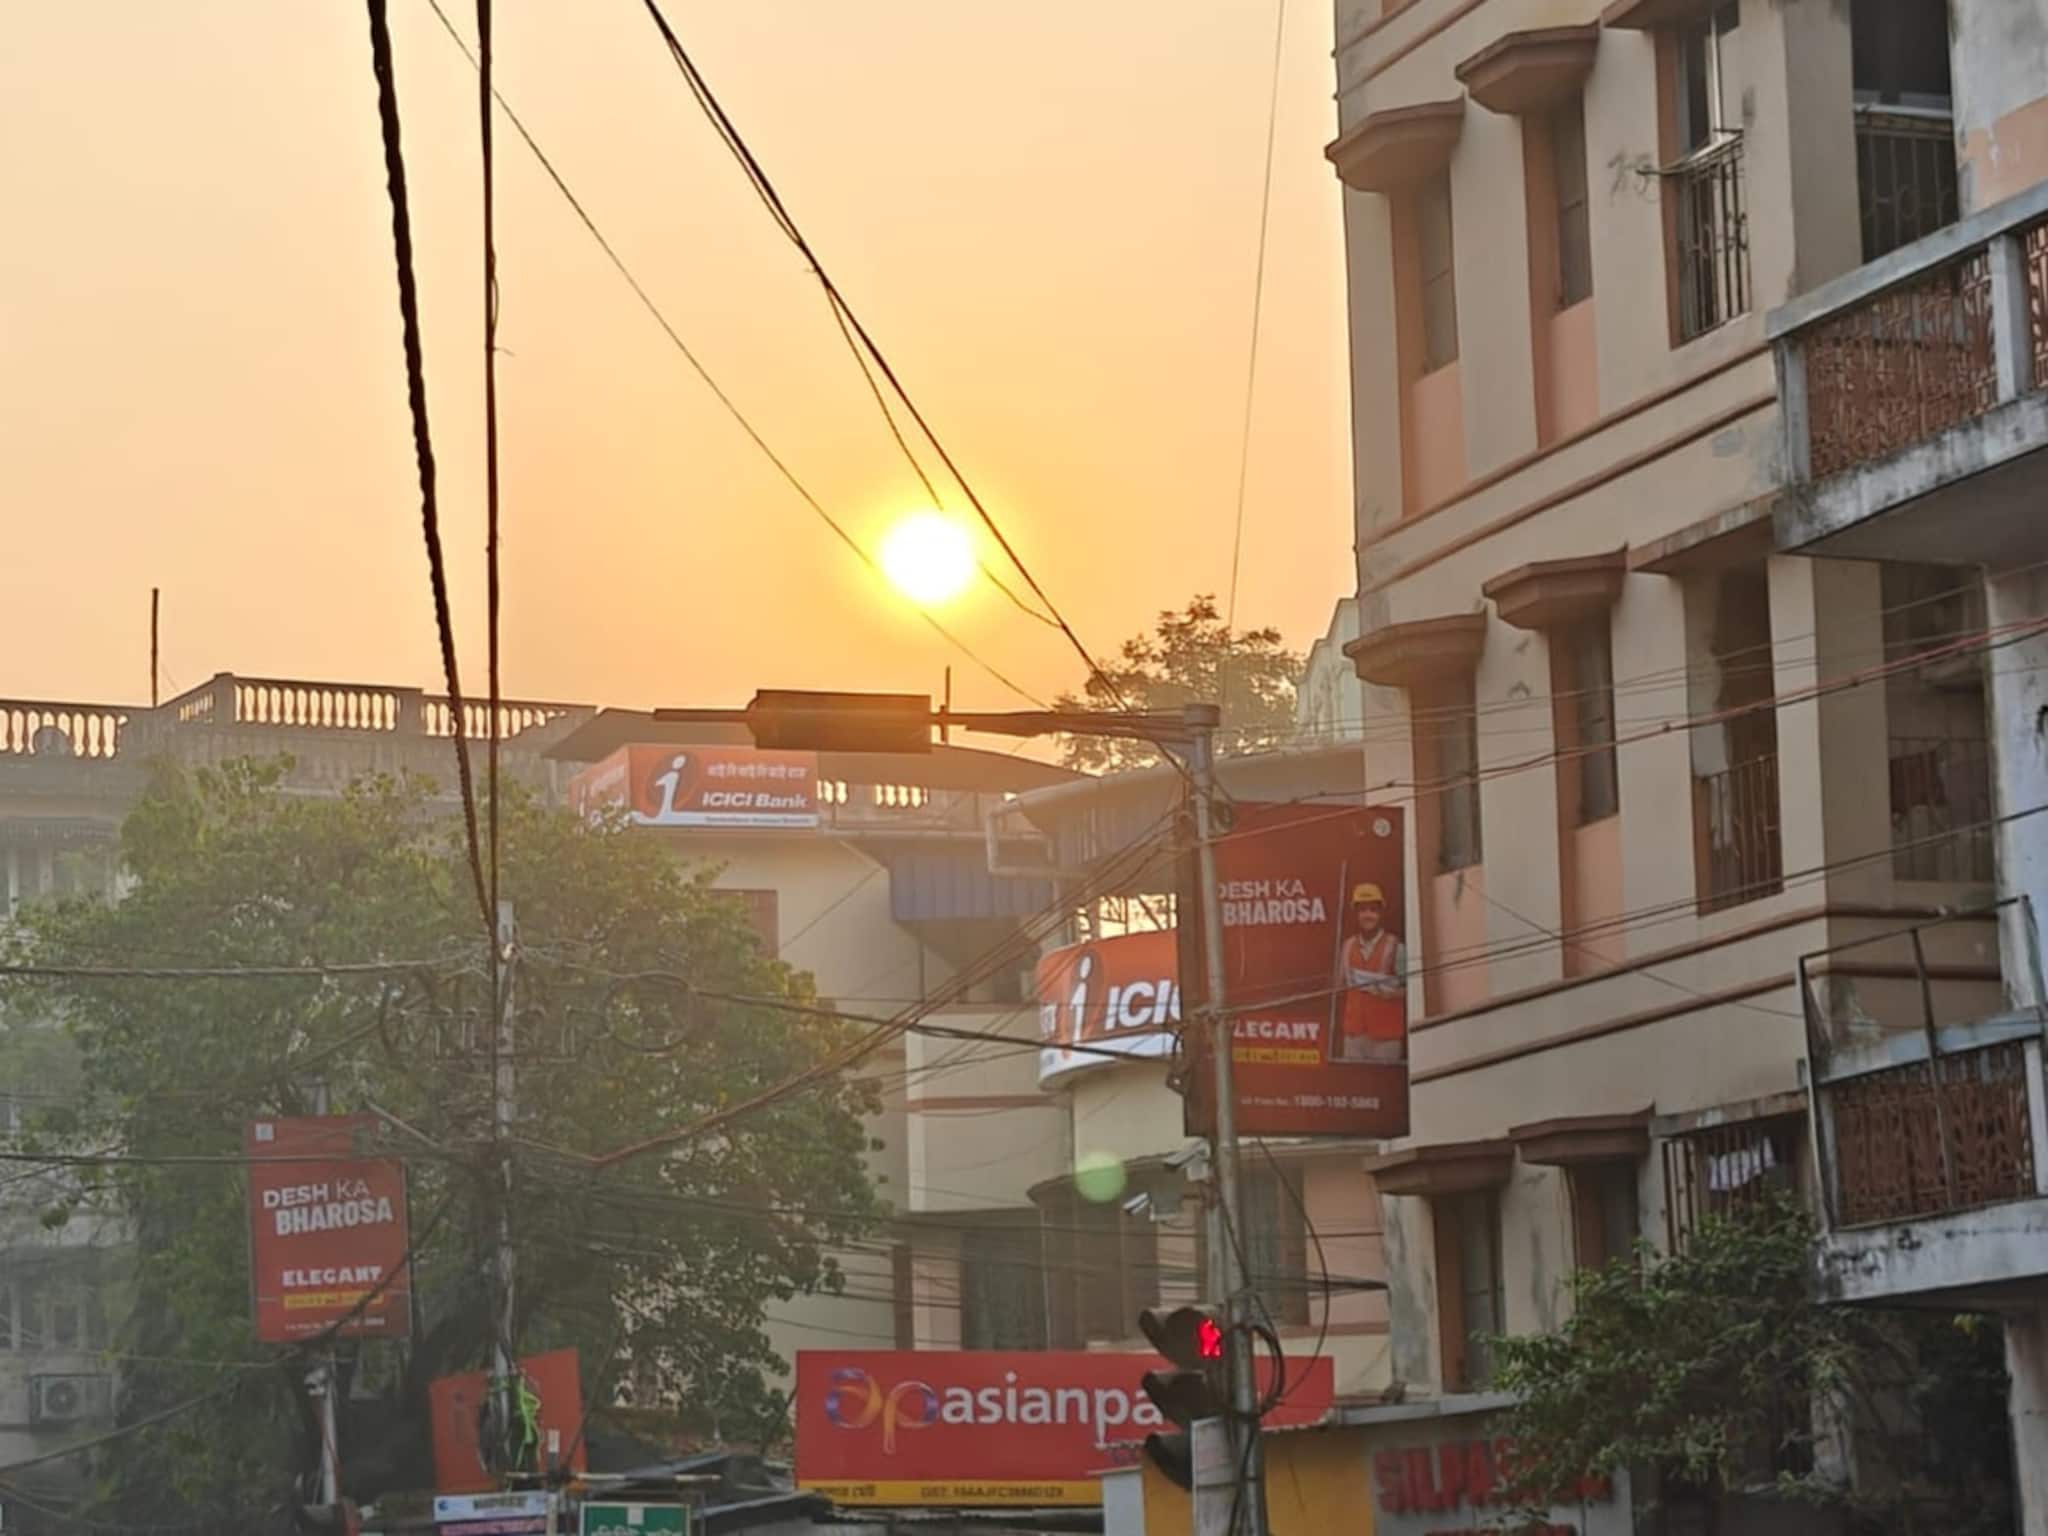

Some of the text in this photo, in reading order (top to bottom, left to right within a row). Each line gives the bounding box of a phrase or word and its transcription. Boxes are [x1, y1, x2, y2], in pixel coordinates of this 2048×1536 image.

[702, 791, 807, 809] ICICI Bank
[1275, 879, 1306, 897] KA
[1222, 897, 1326, 927] BHAROSA
[1232, 1020, 1321, 1040] LEGANT
[262, 1178, 370, 1209] DESH KA
[275, 1197, 394, 1236] BHAROSA
[282, 1265, 382, 1288] ELEGANT
